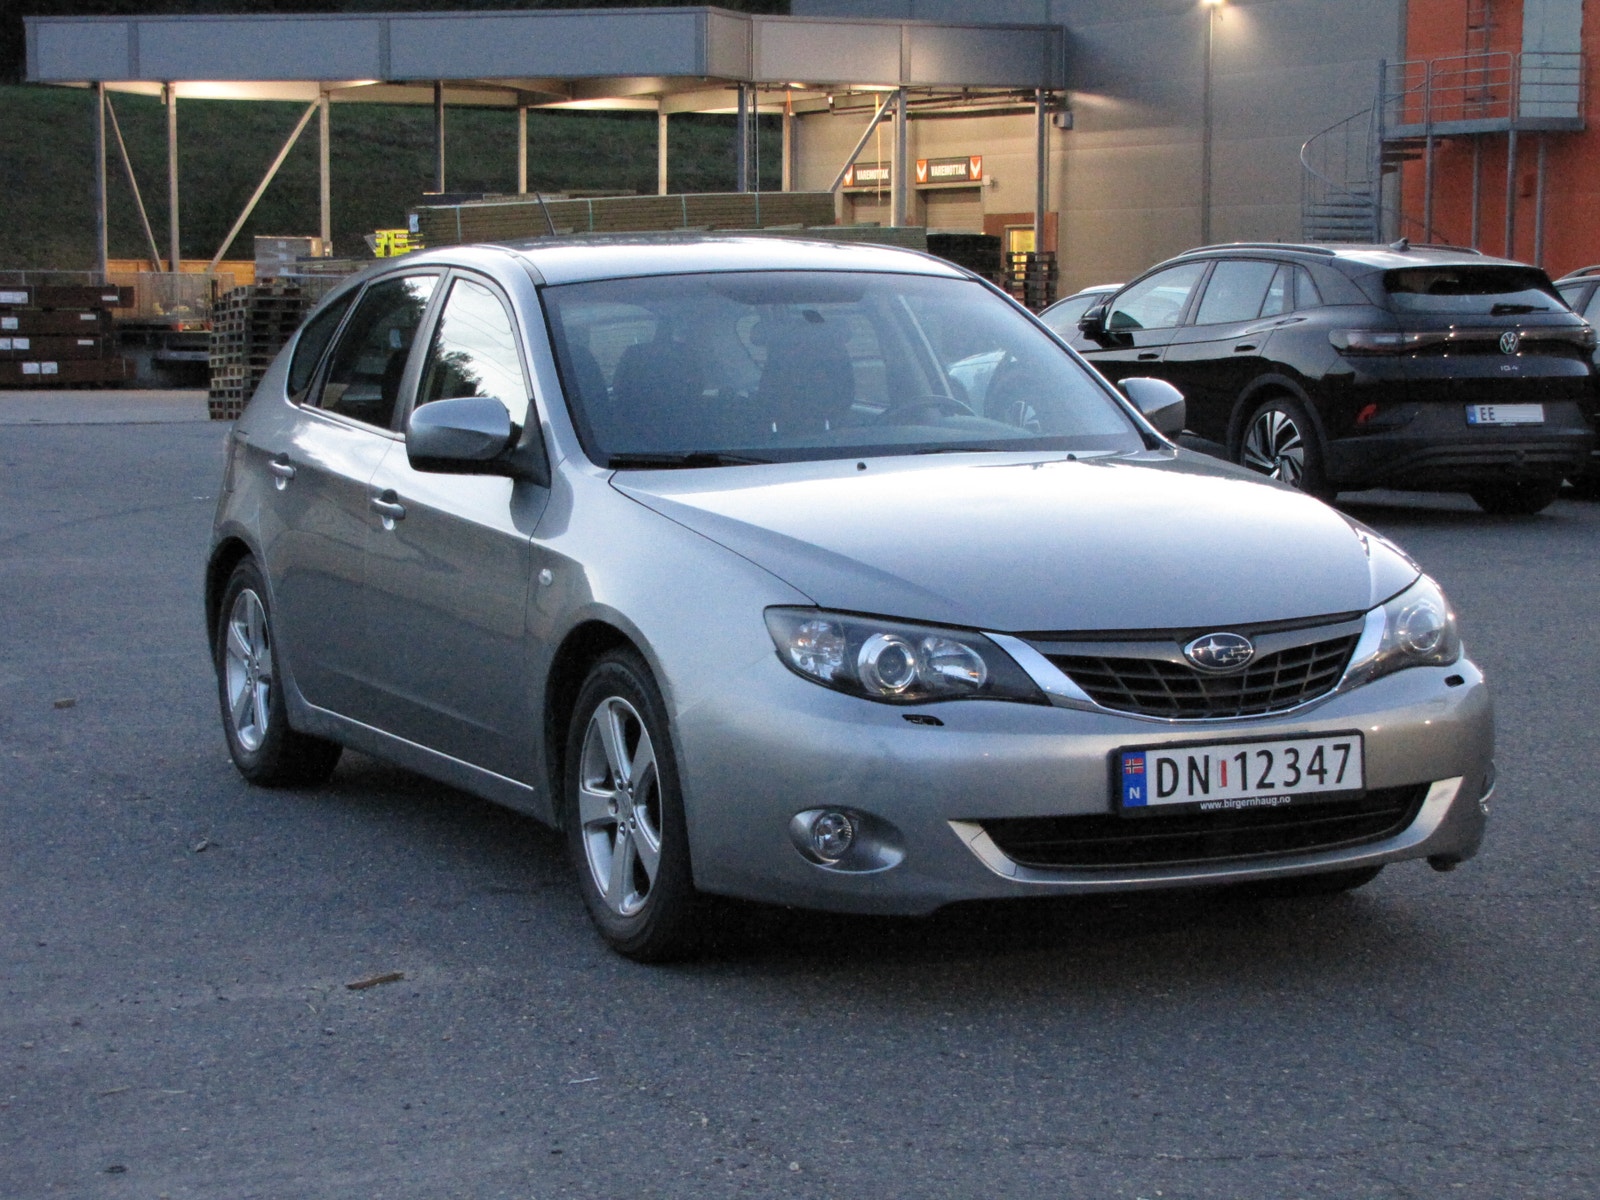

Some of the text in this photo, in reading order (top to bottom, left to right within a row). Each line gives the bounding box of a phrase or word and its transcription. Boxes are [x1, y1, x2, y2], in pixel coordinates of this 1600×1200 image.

[1480, 407, 1496, 421] EE
[1156, 743, 1351, 798] DN 12347
[1129, 786, 1141, 800] N
[1200, 796, 1291, 810] www.birgernhaug.no
